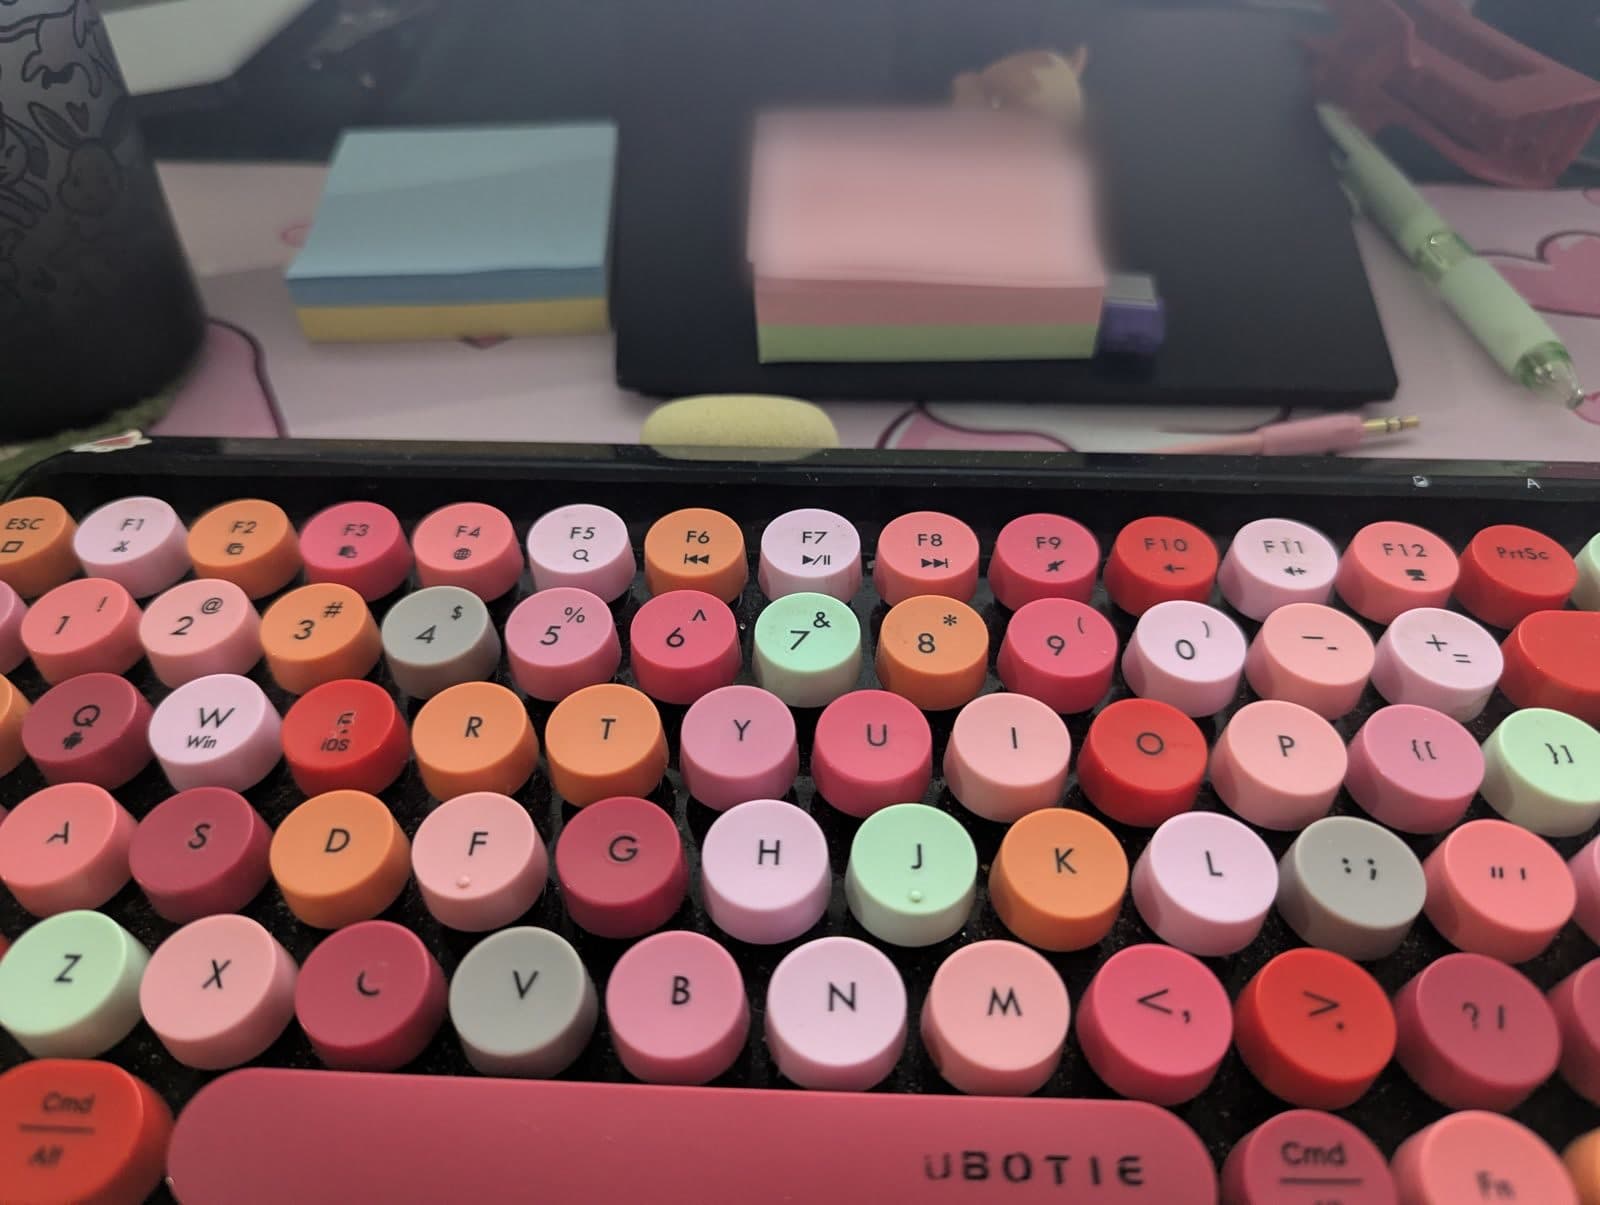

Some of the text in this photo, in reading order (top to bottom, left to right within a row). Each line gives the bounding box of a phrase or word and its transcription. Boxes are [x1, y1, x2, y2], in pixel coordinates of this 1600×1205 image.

[4, 517, 45, 531] ESC
[120, 518, 145, 531] F1
[231, 520, 257, 535] F2
[343, 523, 370, 537] F3
[455, 525, 481, 538] F4
[569, 526, 596, 540] F5
[686, 530, 710, 545] F6
[802, 531, 828, 545] F7
[917, 533, 943, 547] F8
[1035, 536, 1062, 550] F9
[1143, 537, 1189, 553] F10
[1263, 540, 1304, 554] F11
[1382, 542, 1428, 558] F12
[1496, 546, 1549, 561] PrtSc
[96, 596, 109, 613] !
[200, 597, 224, 615] @
[323, 602, 343, 618] #
[451, 605, 463, 621] $
[564, 606, 586, 624] %
[55, 615, 71, 635] 1
[170, 615, 194, 636] 2
[293, 619, 316, 641] 3
[812, 611, 831, 629] &
[1076, 616, 1085, 635] (
[1201, 620, 1211, 639] )
[415, 624, 438, 645] 4
[539, 625, 562, 646] 5
[665, 627, 685, 649] 6
[790, 629, 811, 651] 7
[917, 632, 936, 654] 8
[1046, 634, 1066, 657] 9
[1175, 638, 1196, 661] 0
[1425, 634, 1472, 664] + =
[73, 704, 101, 729] Q
[199, 707, 235, 729] W
[464, 716, 483, 738] R
[600, 717, 617, 741] T
[733, 719, 752, 742] Y
[866, 723, 888, 747] U
[187, 735, 217, 749] Win
[1135, 731, 1165, 757] O
[1277, 734, 1296, 758] P
[188, 823, 211, 850] S
[324, 827, 351, 854] D
[468, 831, 489, 857] F
[608, 834, 639, 863] G
[758, 839, 781, 866] H
[911, 843, 923, 870] J
[1054, 847, 1076, 874] K
[1205, 850, 1223, 878] L
[54, 953, 83, 983] Z
[202, 959, 231, 989] X
[513, 970, 539, 1000] V
[671, 975, 691, 1006] B
[828, 982, 856, 1012] N
[987, 988, 1022, 1017] M
[1136, 988, 1173, 1015] <
[1303, 991, 1340, 1017] >
[41, 1091, 95, 1115] Cmd
[1280, 1141, 1346, 1167] Cmd
[926, 1150, 1144, 1187] UBOTIE
[1475, 1170, 1515, 1199] Fn
